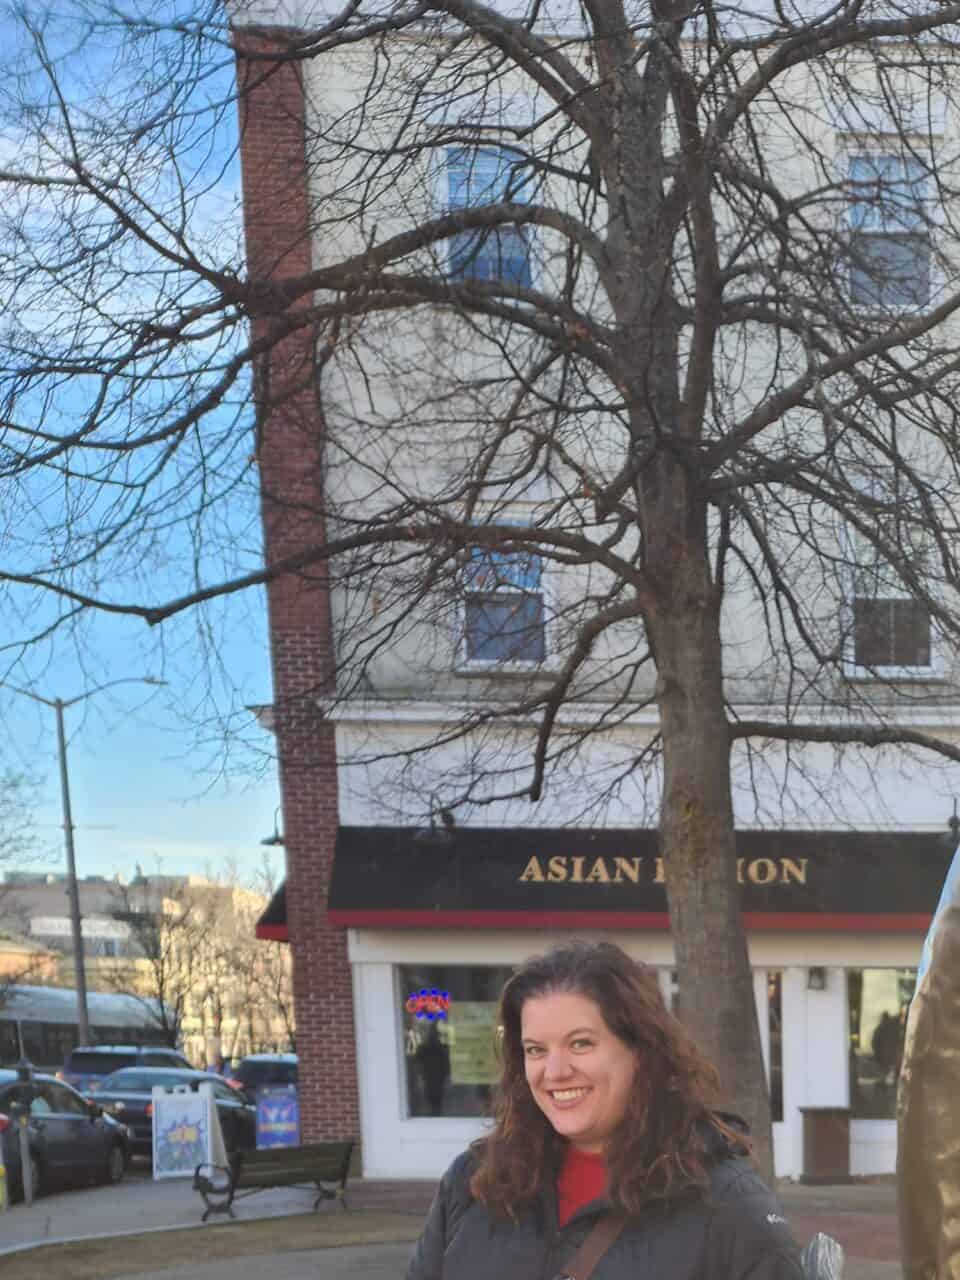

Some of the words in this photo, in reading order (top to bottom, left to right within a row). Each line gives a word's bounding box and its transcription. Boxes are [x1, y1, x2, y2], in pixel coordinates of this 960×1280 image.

[519, 855, 642, 884] ASIAN
[652, 856, 808, 885] ION
[406, 995, 450, 1014] OPEN
